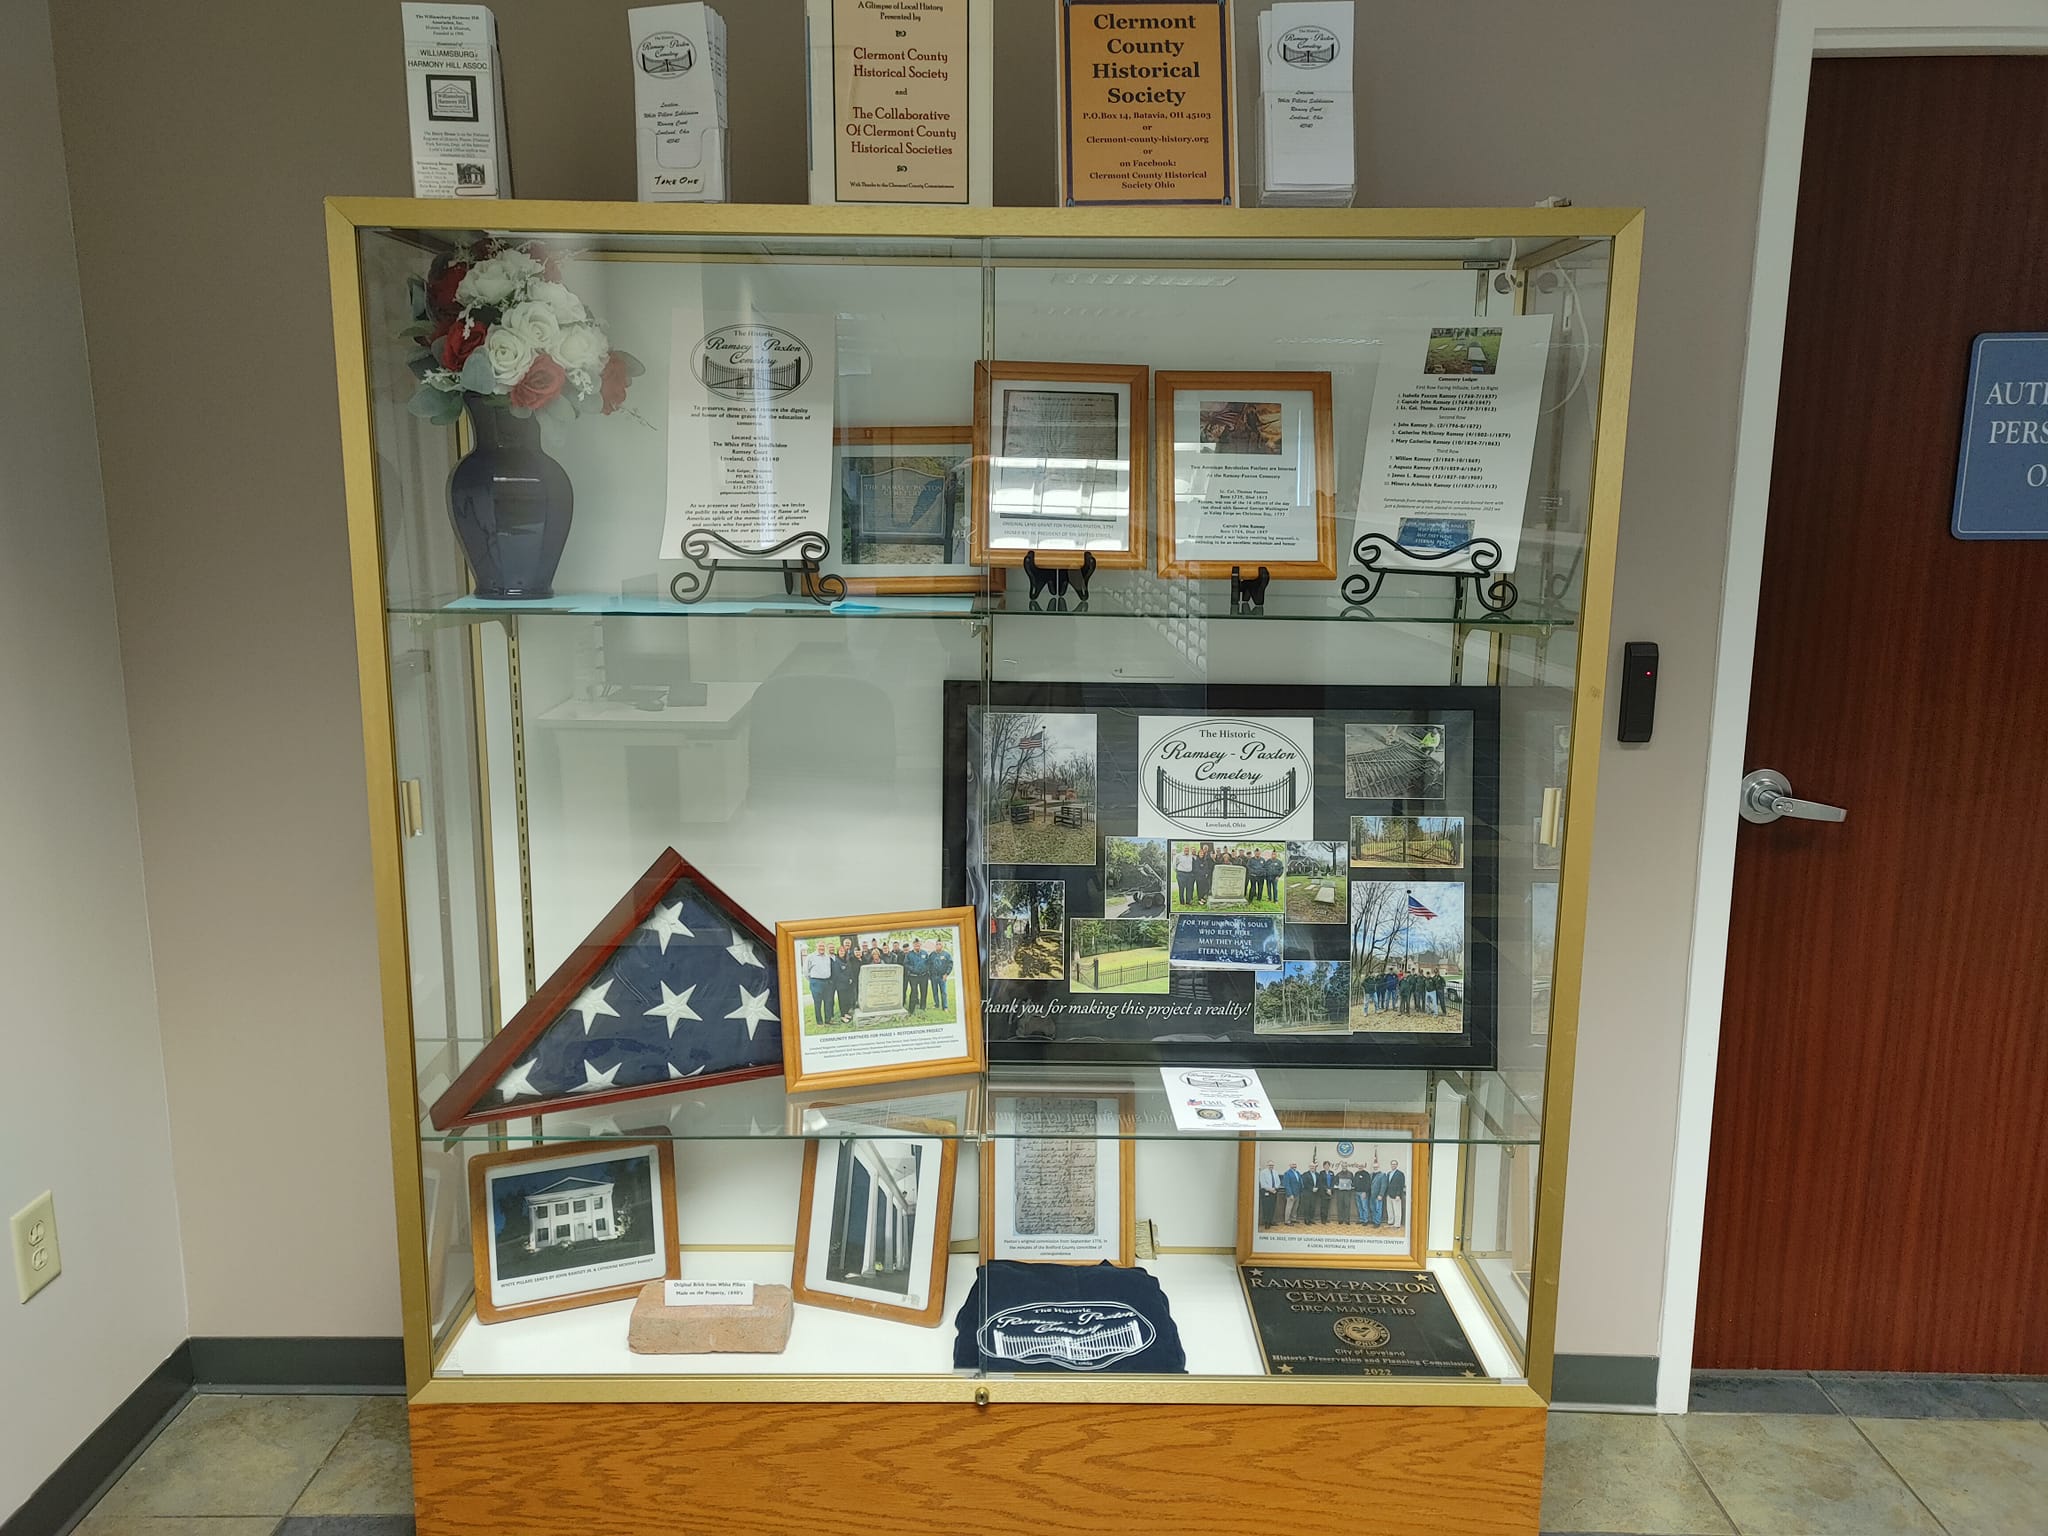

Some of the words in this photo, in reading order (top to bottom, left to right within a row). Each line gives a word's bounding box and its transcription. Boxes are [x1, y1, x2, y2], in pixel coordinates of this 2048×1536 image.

[858, 1, 865, 9] A
[865, 1, 892, 10] Glimpse
[893, 2, 900, 10] of
[901, 2, 919, 10] Local
[920, 3, 943, 11] History
[880, 12, 912, 20] Presented
[913, 12, 921, 22] by
[1094, 14, 1196, 30] Clermont
[854, 47, 905, 60] Clermont
[908, 49, 948, 63] County
[1107, 38, 1184, 57] County
[854, 65, 906, 78] Historical
[909, 66, 948, 81] Society
[1093, 62, 1200, 79] Historical
[895, 88, 908, 96] and
[1108, 87, 1186, 106] Society
[852, 106, 873, 119] The
[875, 107, 950, 120] Collaborative
[846, 124, 861, 136] Of
[863, 124, 915, 137] Clermont
[916, 125, 956, 140] County
[1086, 135, 1209, 144] Clermont-county-history.org
[851, 141, 903, 154] Historical
[906, 142, 953, 155] Societies
[654, 176, 677, 186] TAKE
[679, 176, 699, 185] ONE
[1132, 172, 1162, 180] County
[1165, 171, 1207, 179] Historical
[1122, 182, 1153, 190] Society
[706, 337, 751, 353] Ramsey
[762, 338, 801, 352] Paxton
[730, 351, 777, 368] Cemetery
[2027, 463, 2048, 487] O
[1200, 729, 1217, 738] The
[1220, 730, 1256, 739] Historic
[1161, 740, 1228, 763] Ramsey
[1240, 741, 1297, 761] Paxton
[1195, 761, 1264, 785] Cemetery
[979, 1000, 1017, 1014] Thank
[1019, 1003, 1044, 1020] you
[1046, 1001, 1068, 1019] for
[1070, 1001, 1118, 1019] making
[1121, 1001, 1144, 1014] this
[1146, 1002, 1192, 1020] project
[1194, 1006, 1202, 1016] a
[1205, 1001, 1252, 1020] reality!
[1250, 1277, 1438, 1295] RAMSEY-PAXTON
[1286, 1291, 1408, 1306] CEMETERY
[1291, 1304, 1333, 1312] CIRCA
[1335, 1305, 1387, 1314] MARCH
[1391, 1307, 1416, 1316] 1813
[997, 1316, 1065, 1329] Ramsey
[1079, 1311, 1136, 1324] Paxton
[1034, 1323, 1104, 1335] Cemetery
[1383, 1358, 1421, 1366] Planning
